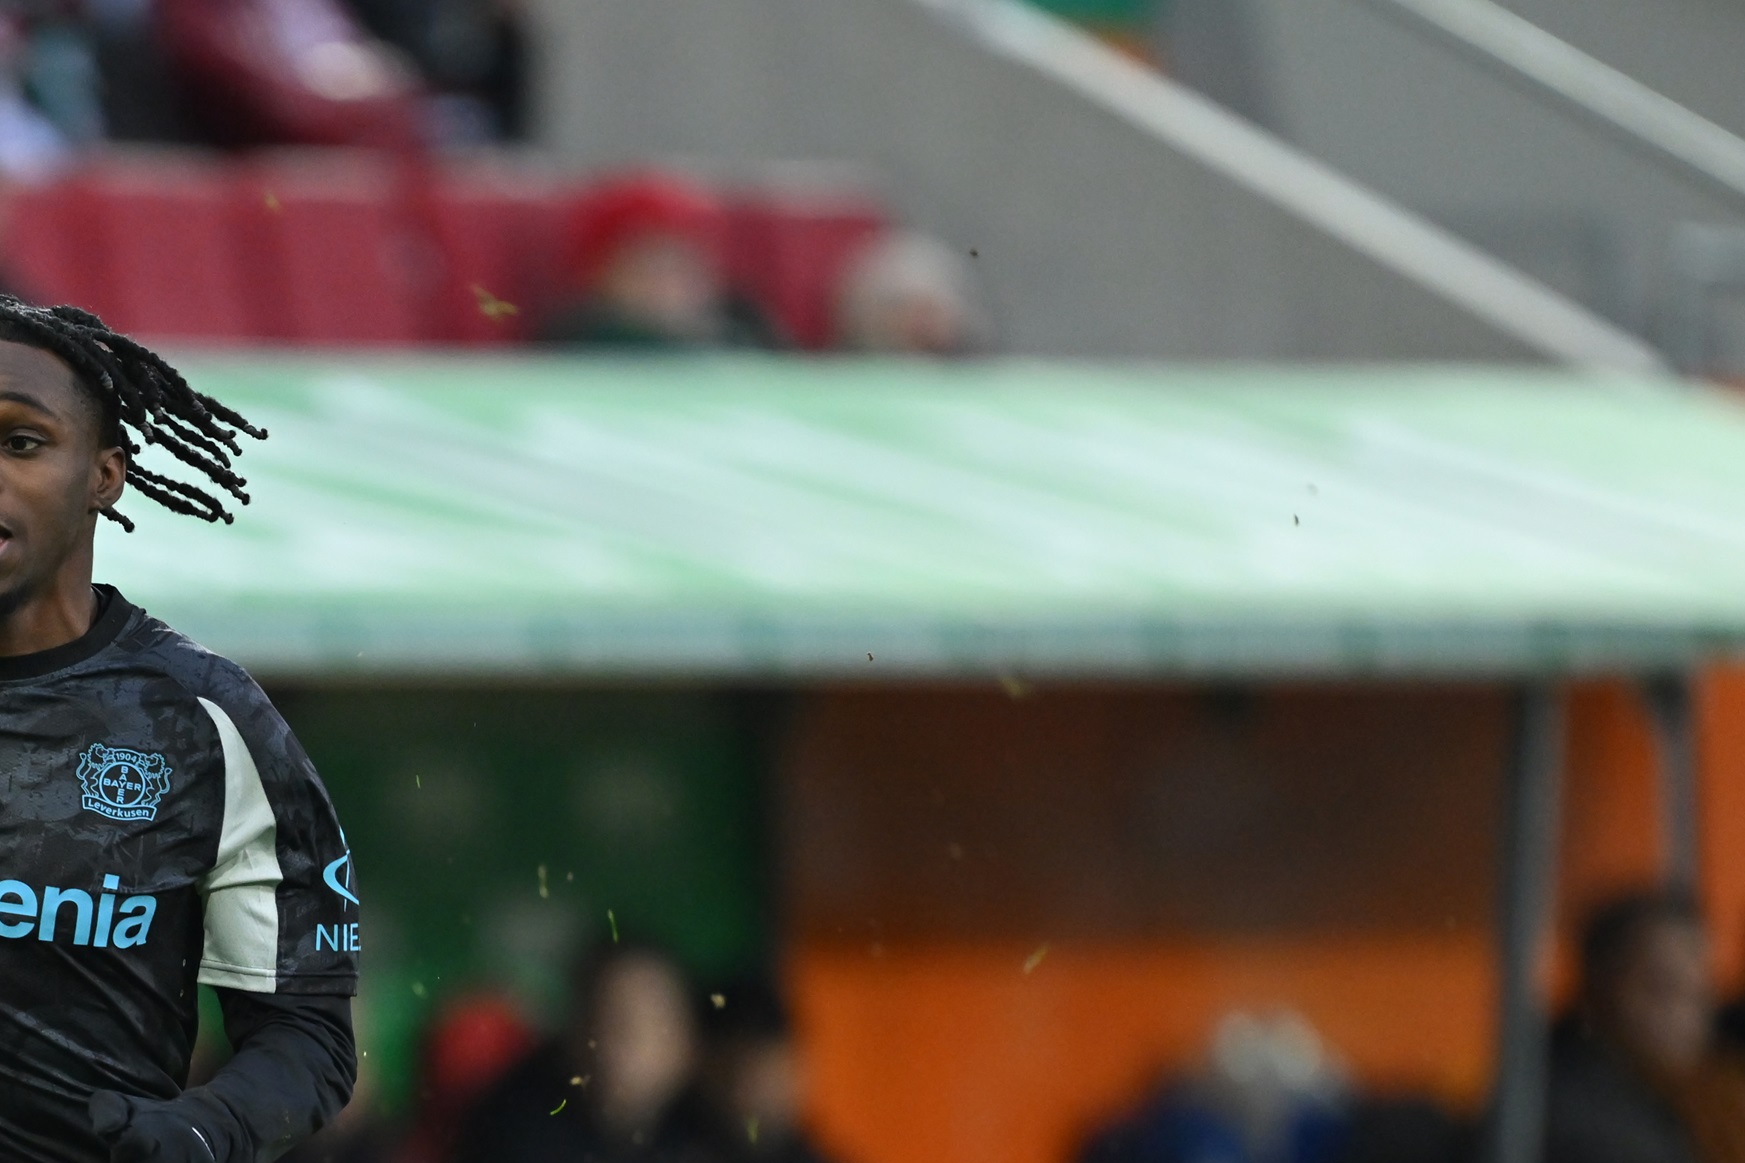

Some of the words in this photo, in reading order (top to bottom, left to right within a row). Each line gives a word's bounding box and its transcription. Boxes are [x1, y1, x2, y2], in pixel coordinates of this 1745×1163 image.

[116, 752, 137, 763] 1904
[103, 777, 142, 792] BAYER
[116, 765, 129, 804] BAYER
[88, 798, 149, 818] Leverkusen
[315, 922, 362, 952] NIE
